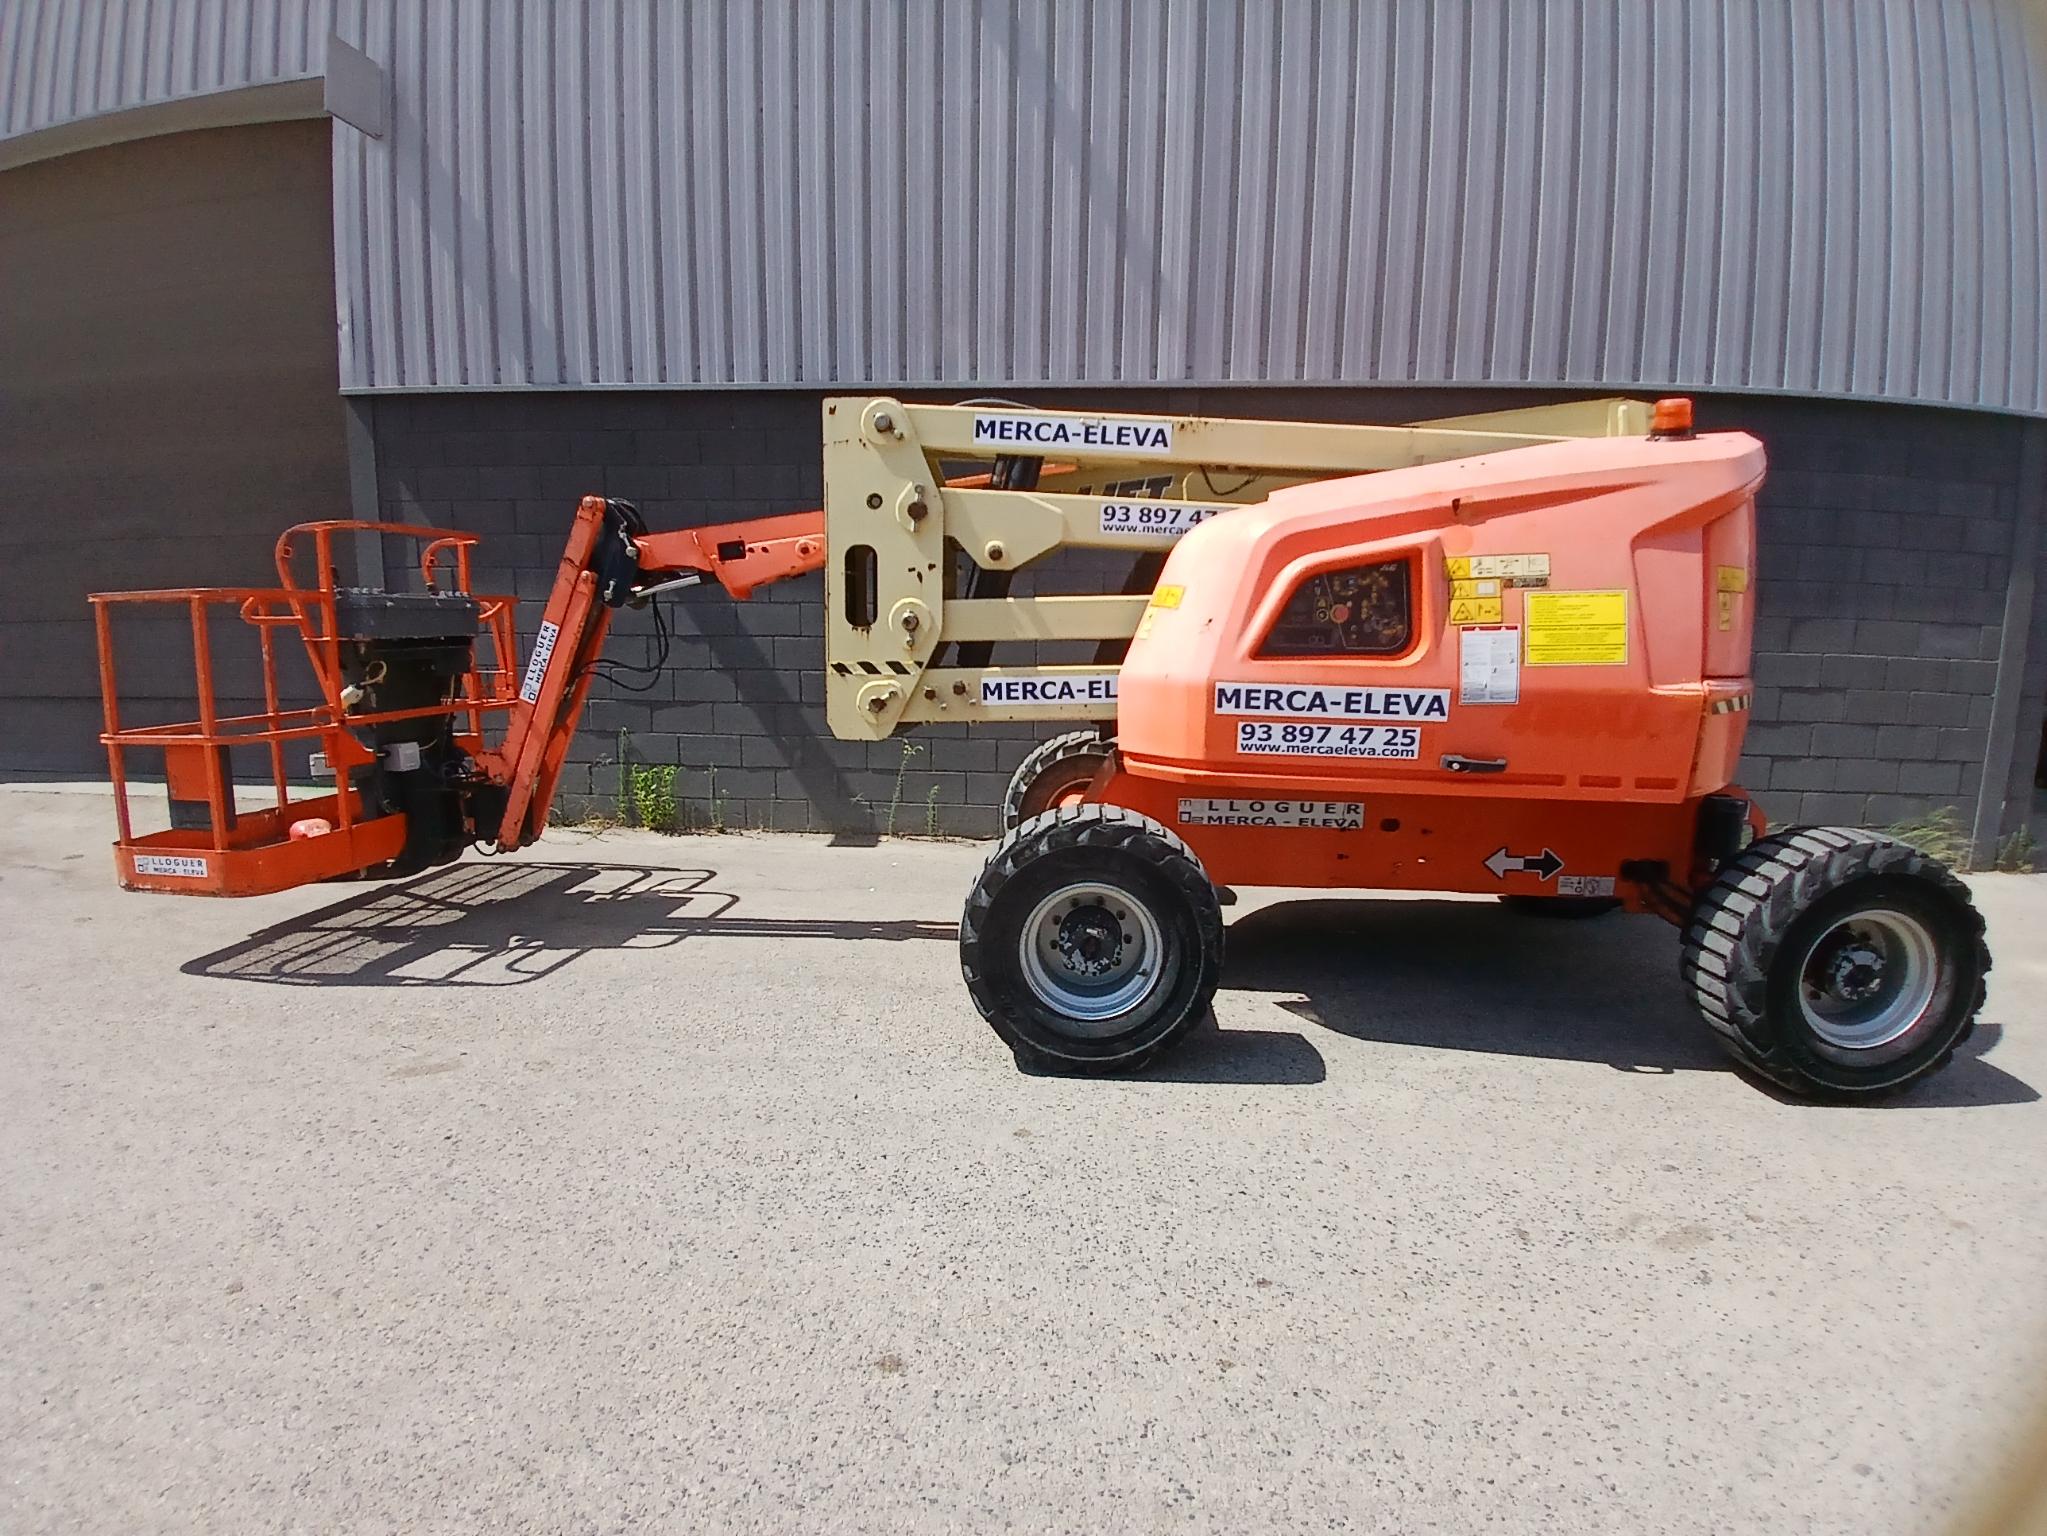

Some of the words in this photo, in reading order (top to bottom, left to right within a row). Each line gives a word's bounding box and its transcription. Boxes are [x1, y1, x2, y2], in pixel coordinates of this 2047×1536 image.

[974, 418, 1169, 448] MERCA-ELEVA
[1103, 505, 1130, 523] 93
[1138, 506, 1182, 525] 897
[528, 625, 550, 681] LLOGUER
[1216, 687, 1447, 717] MERCA-ELEVA
[1241, 723, 1273, 742] 93
[1281, 725, 1332, 744] 897
[1340, 727, 1374, 745] 47
[1383, 728, 1417, 747] 25
[1240, 742, 1415, 758] www.mercaeleva.com
[1207, 800, 1361, 815] LLOGUER
[1207, 815, 1277, 826] MERCA
[1298, 817, 1360, 828] ELEVA
[152, 858, 203, 867] LLOGUER
